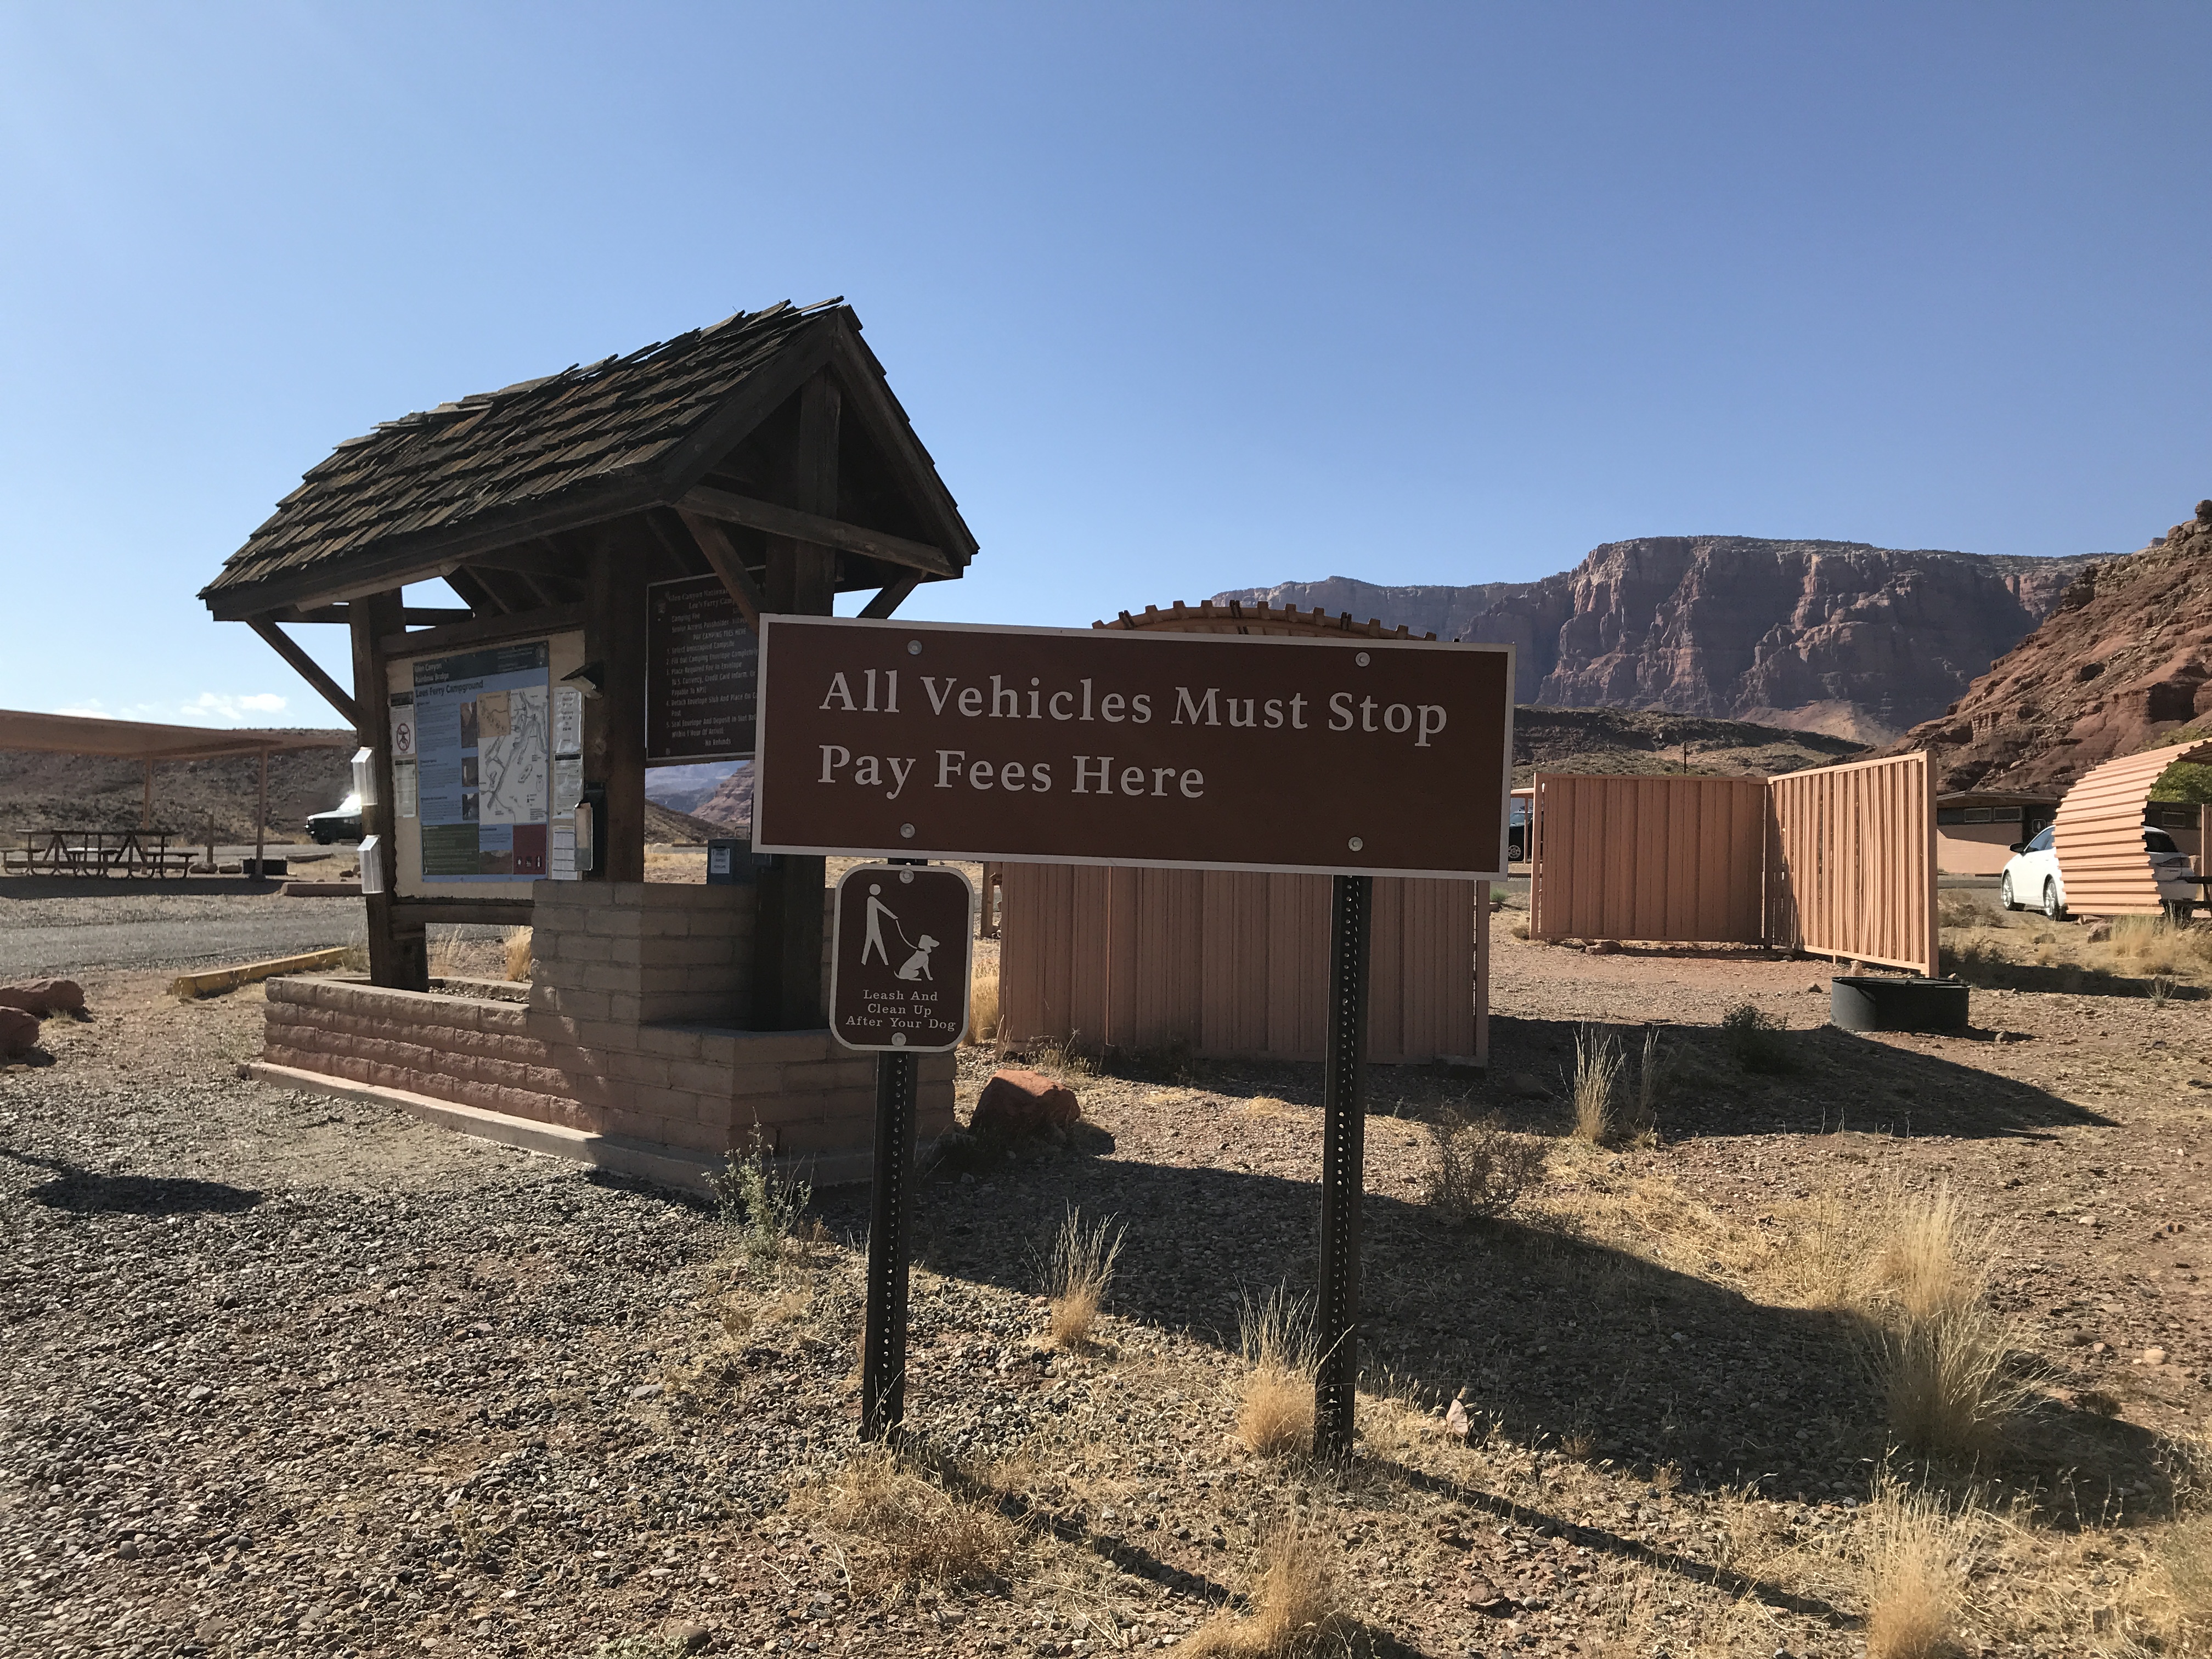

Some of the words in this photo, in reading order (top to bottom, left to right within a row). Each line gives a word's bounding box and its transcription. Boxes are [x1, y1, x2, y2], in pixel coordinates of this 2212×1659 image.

[430, 687, 444, 696] Ferry
[446, 680, 483, 694] Campground
[819, 669, 900, 713] All
[921, 675, 1152, 724] Vehicles
[1171, 687, 1308, 730] Must
[1329, 692, 1447, 748] Stop
[818, 745, 917, 800] Pay
[934, 750, 1052, 793] Fees
[1071, 755, 1204, 799] Here
[863, 990, 905, 1001] Leash
[911, 991, 939, 1002] And
[867, 1003, 906, 1014] Clean
[914, 1006, 932, 1018] Up
[845, 1016, 883, 1027] After
[890, 1018, 922, 1029] Your
[928, 1019, 956, 1032] Dog
